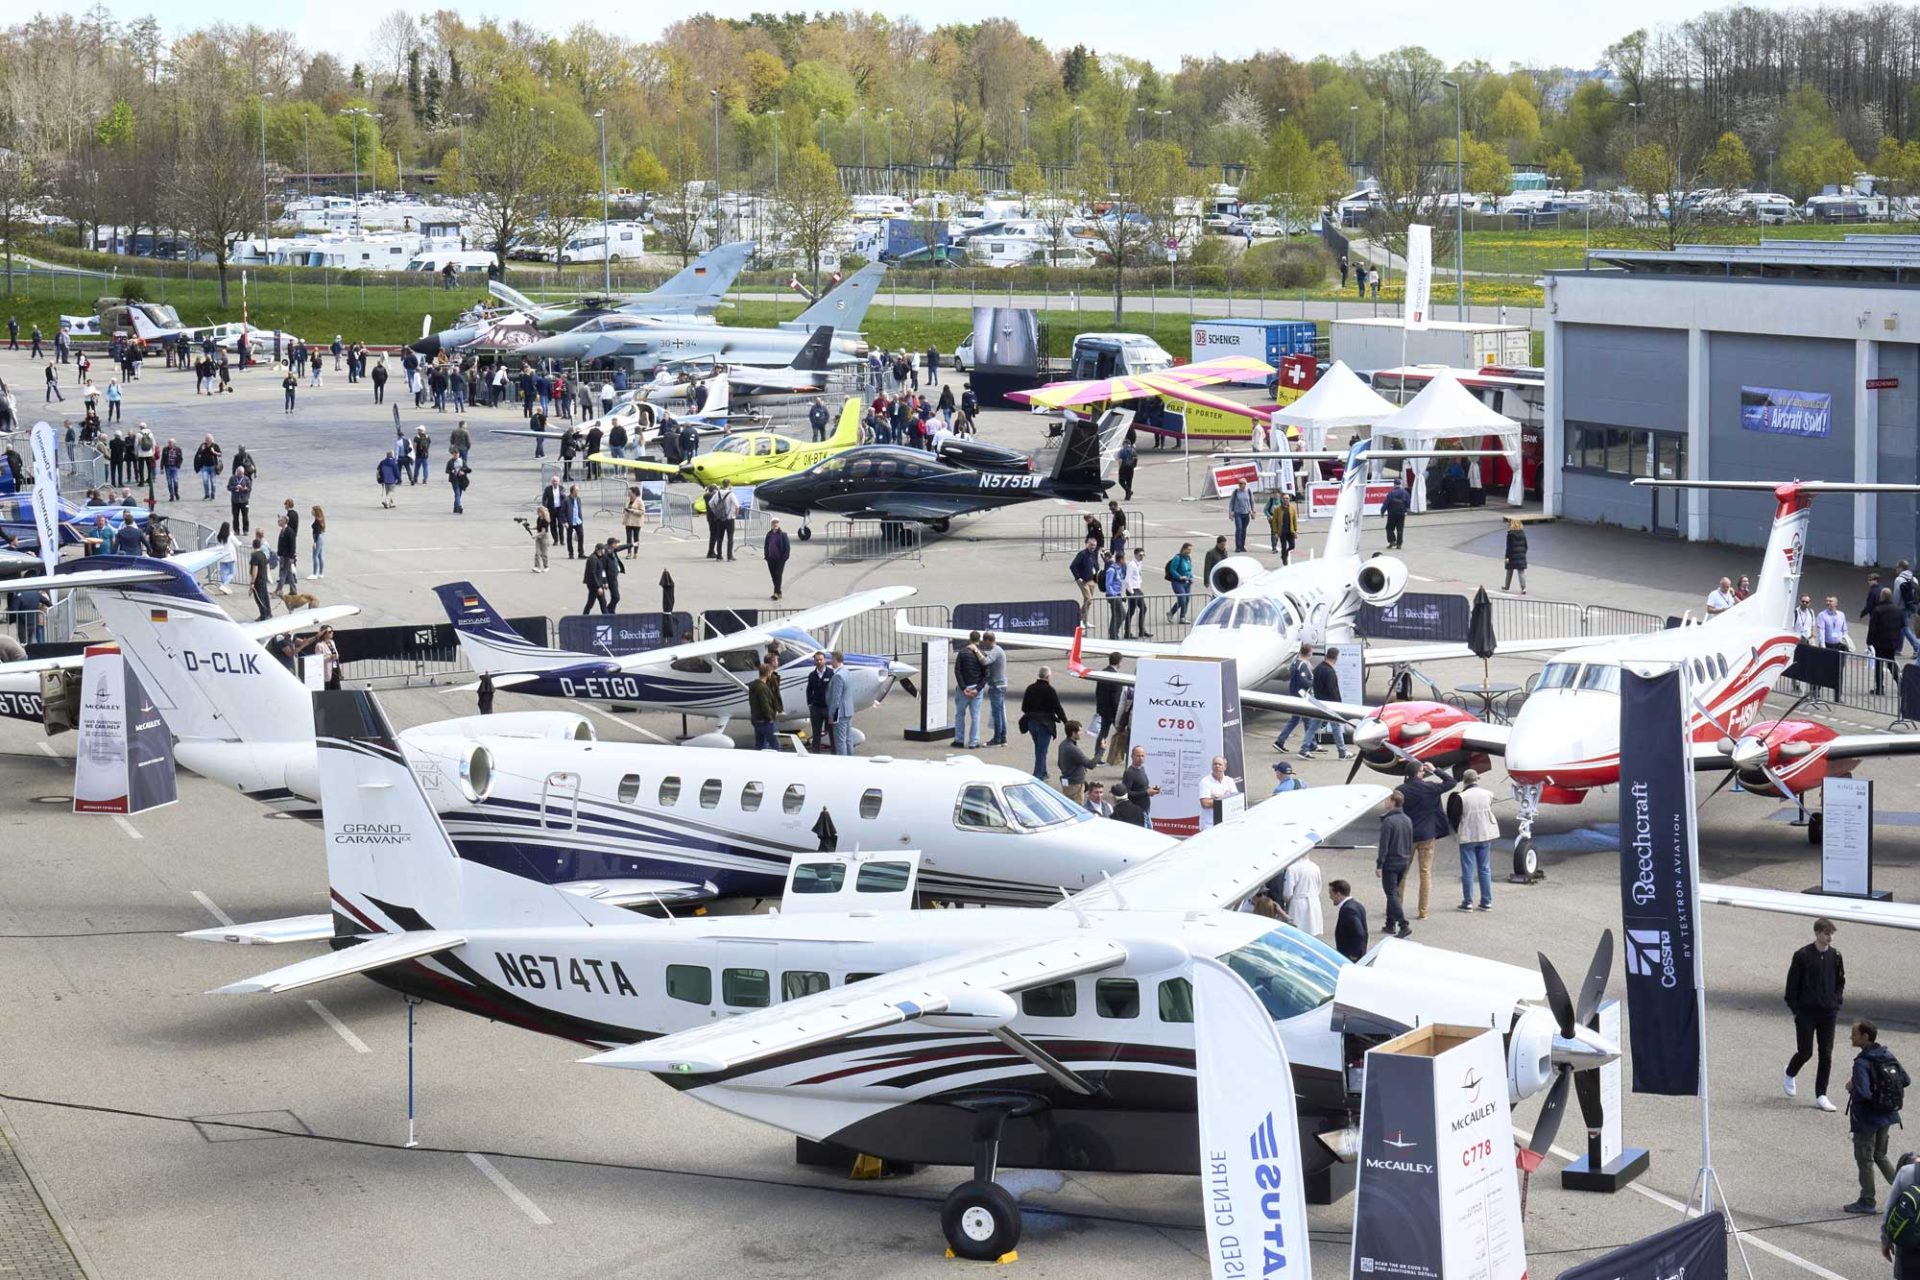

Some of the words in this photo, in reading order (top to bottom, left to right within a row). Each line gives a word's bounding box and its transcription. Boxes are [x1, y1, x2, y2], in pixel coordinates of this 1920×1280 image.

[1208, 334, 1240, 345] SCHENKER
[1195, 410, 1223, 419] PORTER
[1771, 408, 1801, 431] Aircraft
[1803, 411, 1828, 433] Sold!
[1523, 434, 1538, 443] BANK
[979, 474, 1043, 488] N575BW
[619, 629, 661, 641] Beechcraft
[183, 650, 262, 675] D-CLIK
[560, 677, 640, 698] D-ETGO
[1149, 698, 1206, 709] McCAULEY
[1158, 718, 1195, 730] C780
[343, 824, 402, 833] GRAND
[335, 835, 401, 844] CARAVAN
[1631, 781, 1656, 906] Beechcraft
[1673, 813, 1681, 874] AVIATION
[1676, 879, 1689, 937] TEXTRON
[1683, 943, 1691, 957] BY
[1661, 930, 1677, 988] Cessna
[495, 952, 639, 997] N674TA
[1451, 1101, 1497, 1132] McCAULEY
[1462, 1139, 1492, 1167] C778
[1366, 1158, 1433, 1174] McCAULEY
